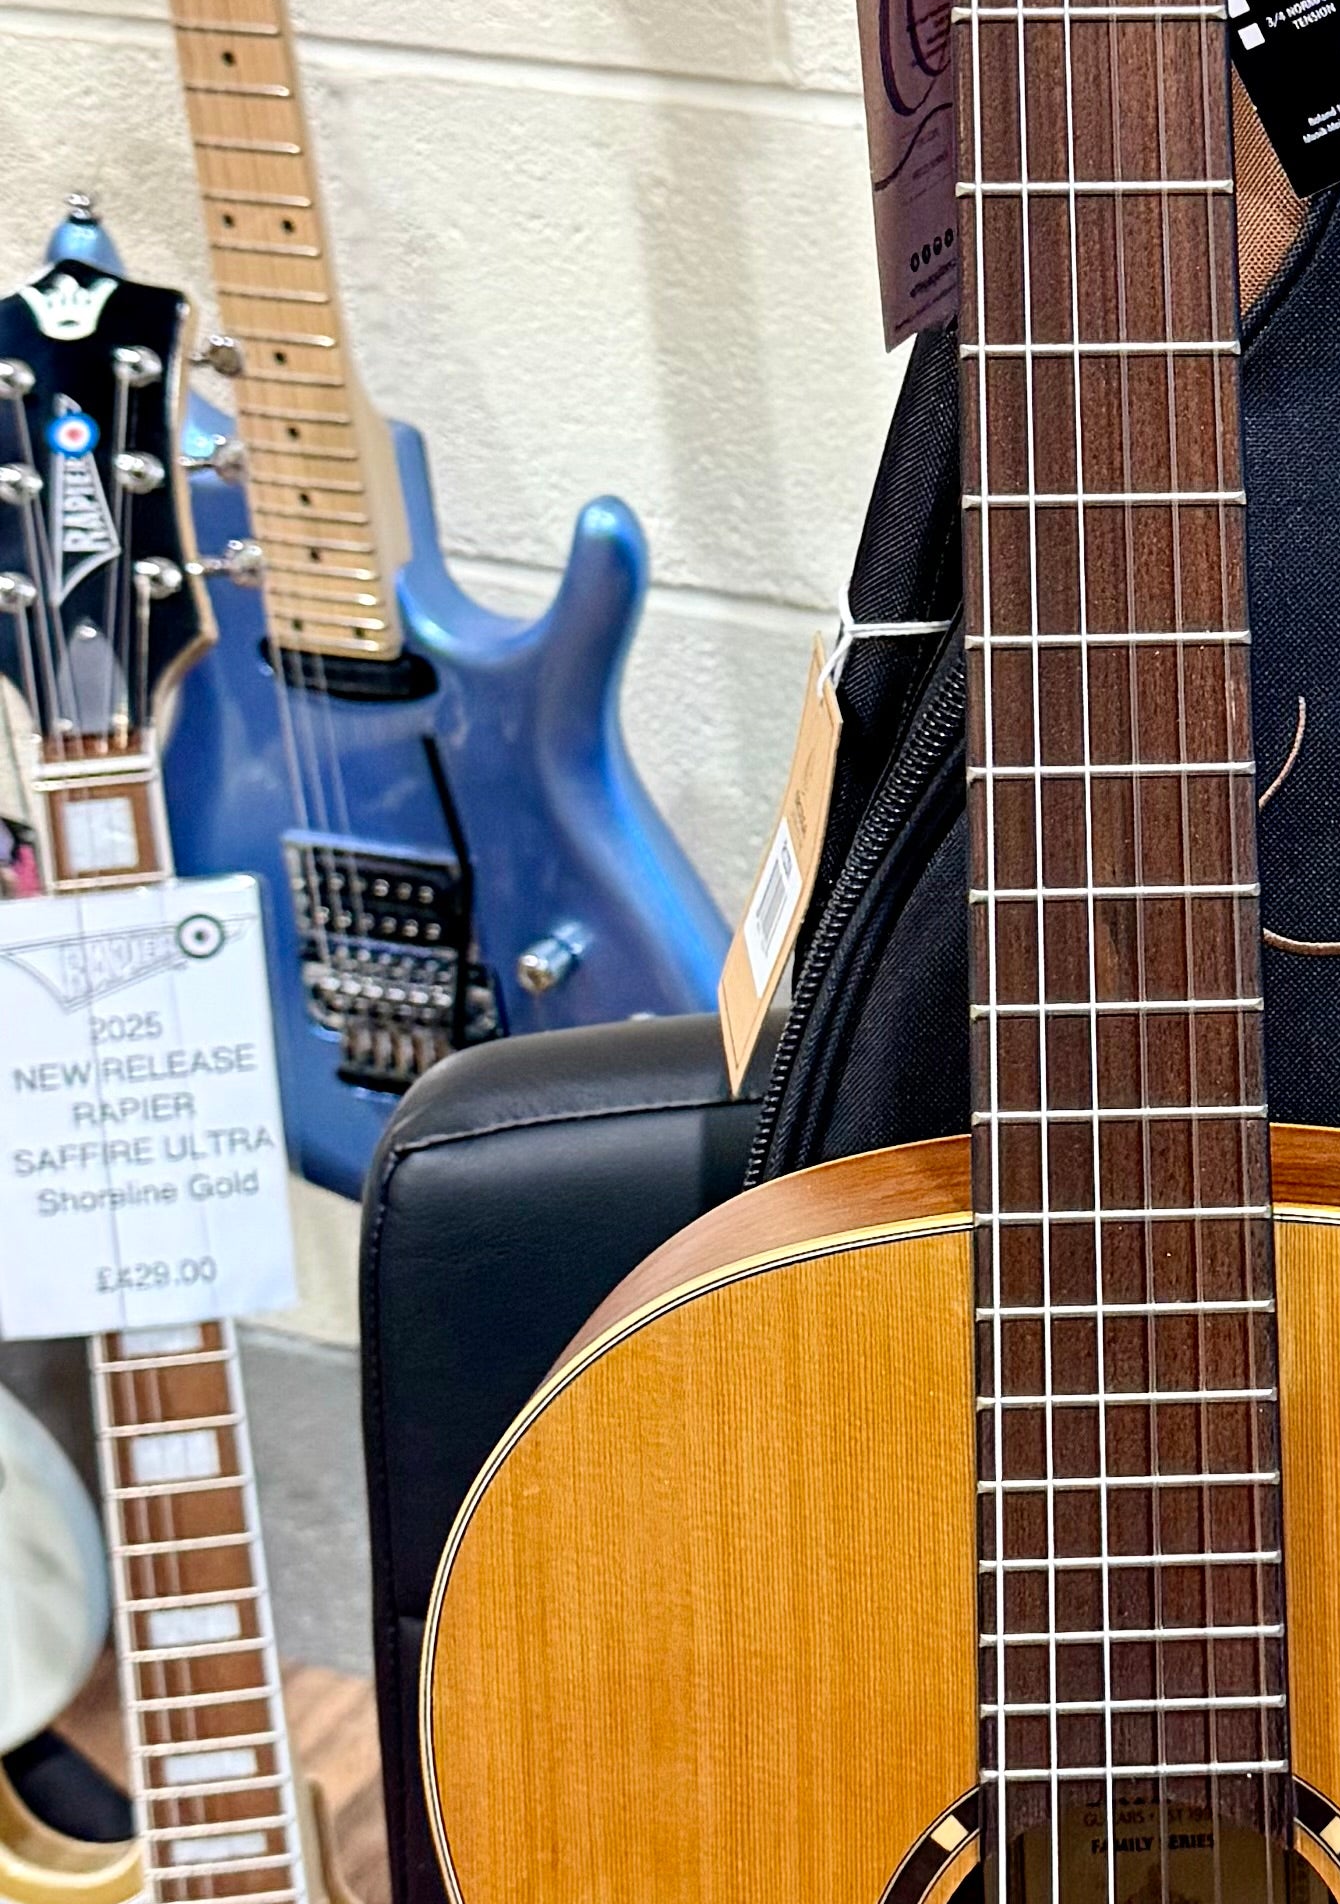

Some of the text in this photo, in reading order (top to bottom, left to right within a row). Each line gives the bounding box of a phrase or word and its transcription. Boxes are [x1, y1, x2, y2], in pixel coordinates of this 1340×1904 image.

[1265, 11, 1287, 28] 3/4
[1291, 2, 1337, 30] TENSION
[91, 1016, 163, 1043] 2025
[14, 1042, 258, 1093] NEW RELEASE
[72, 1091, 197, 1129] RAPIER
[14, 1124, 276, 1178] SAFFIRE ULTRA
[38, 1168, 259, 1217] Shoreline Gold
[1160, 1833, 1215, 1849] ERIES
